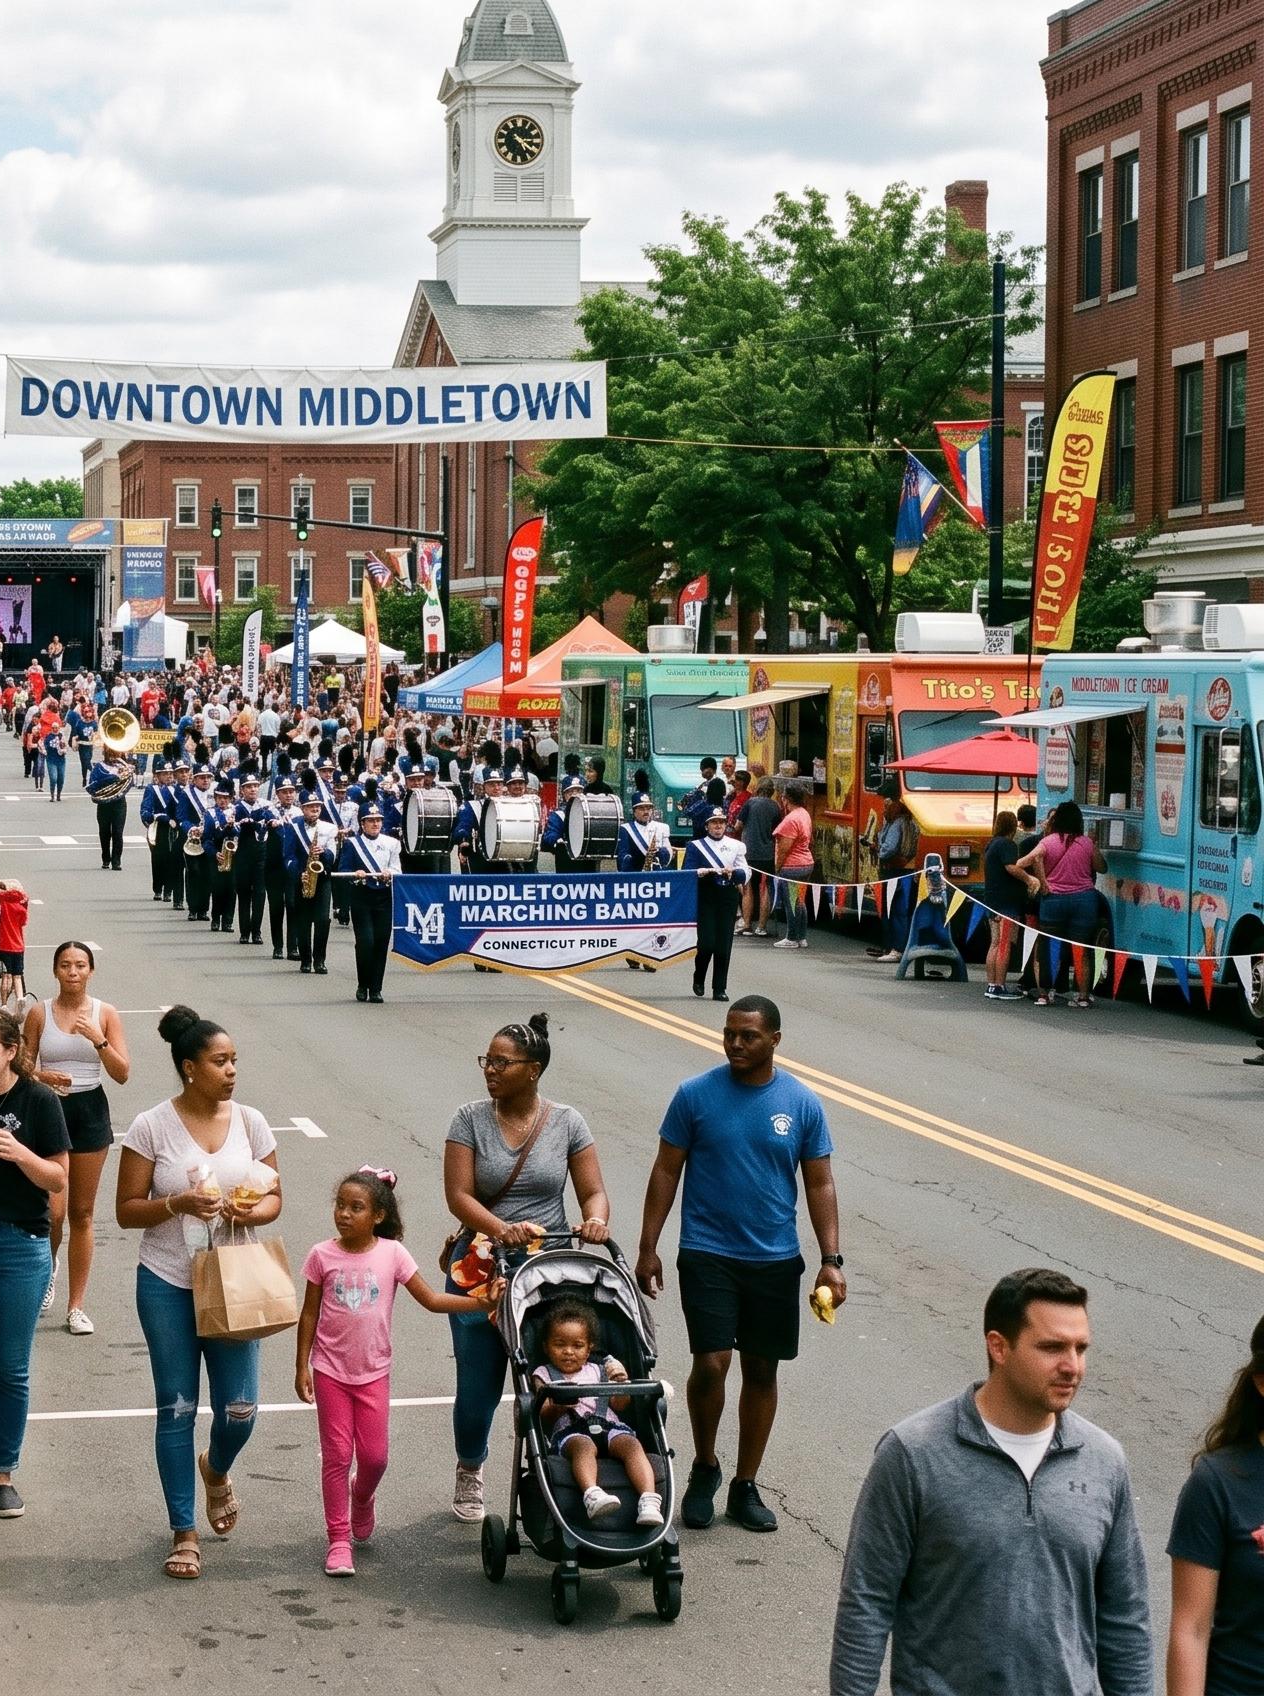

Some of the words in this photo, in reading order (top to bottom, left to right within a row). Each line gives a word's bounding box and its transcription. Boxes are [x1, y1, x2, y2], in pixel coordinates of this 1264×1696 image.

[20, 376, 283, 426] DOWNTOWN
[299, 379, 593, 427] MIDDLETOWN
[1072, 677, 1120, 693] MIDDLETOWN
[1124, 678, 1137, 693] ICE
[448, 882, 605, 902] MIDDLETOWN
[613, 881, 671, 899] HIGH
[461, 902, 587, 922] MARCHING
[595, 902, 659, 920] BAND
[483, 939, 574, 950] CONNECTICUT
[580, 938, 617, 948] PRIDE
